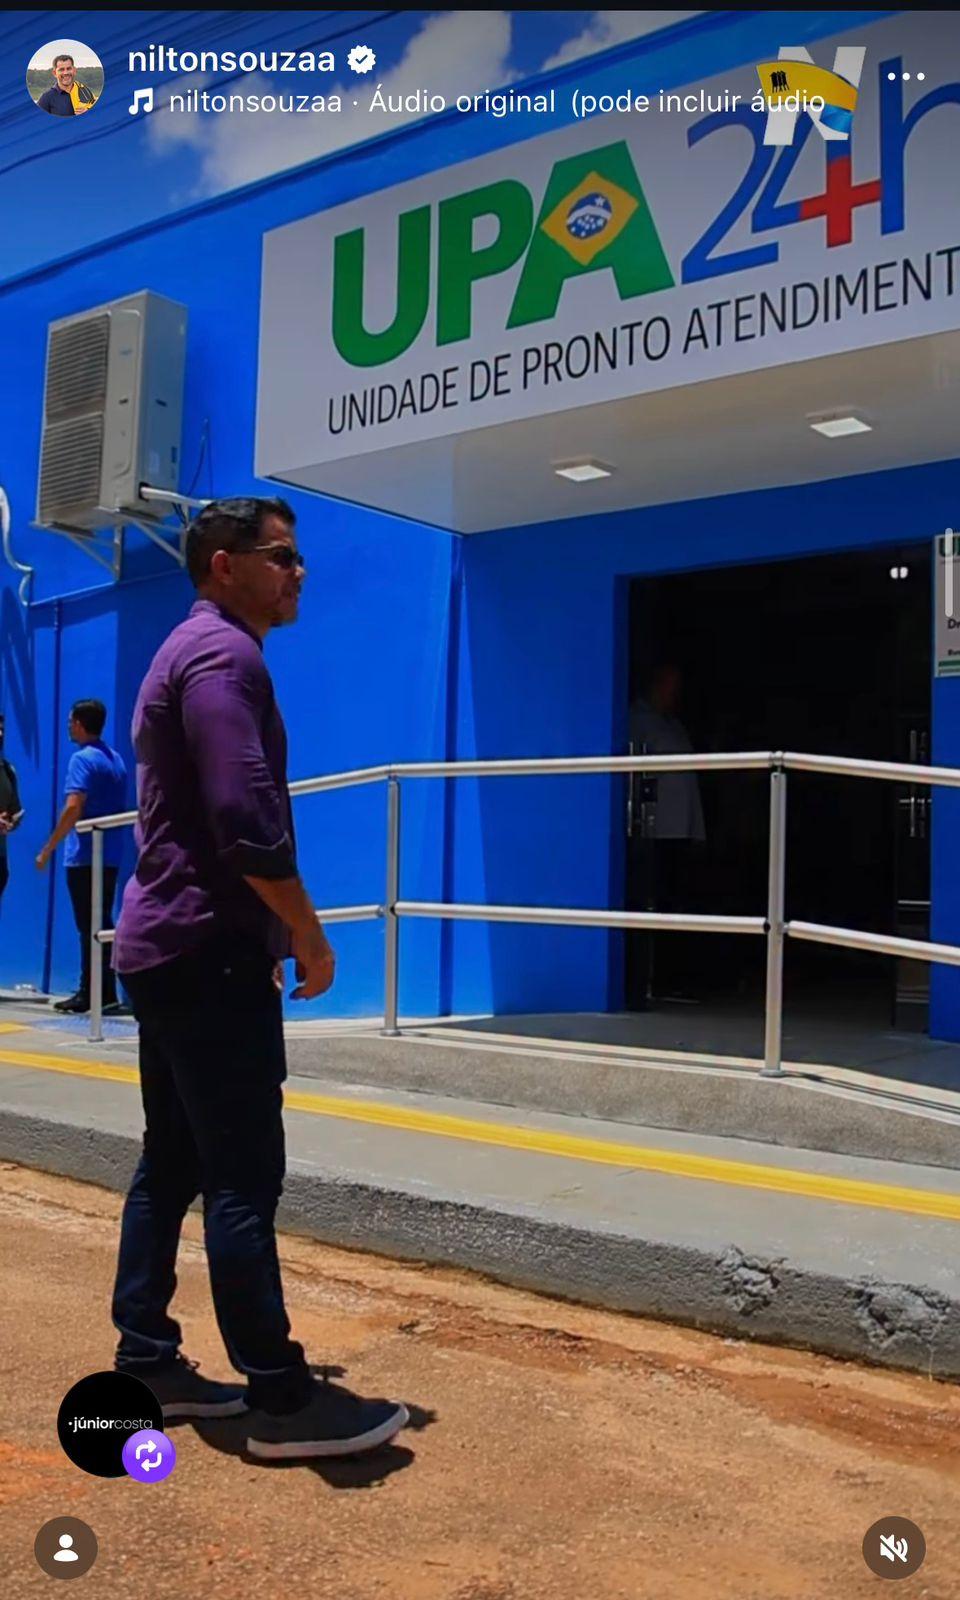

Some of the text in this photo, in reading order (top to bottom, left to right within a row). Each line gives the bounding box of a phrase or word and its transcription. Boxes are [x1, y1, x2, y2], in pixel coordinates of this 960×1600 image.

[332, 140, 675, 368] UPA
[327, 366, 459, 435] UNIDADE
[469, 354, 512, 402] DE
[521, 316, 672, 390] PRONTO
